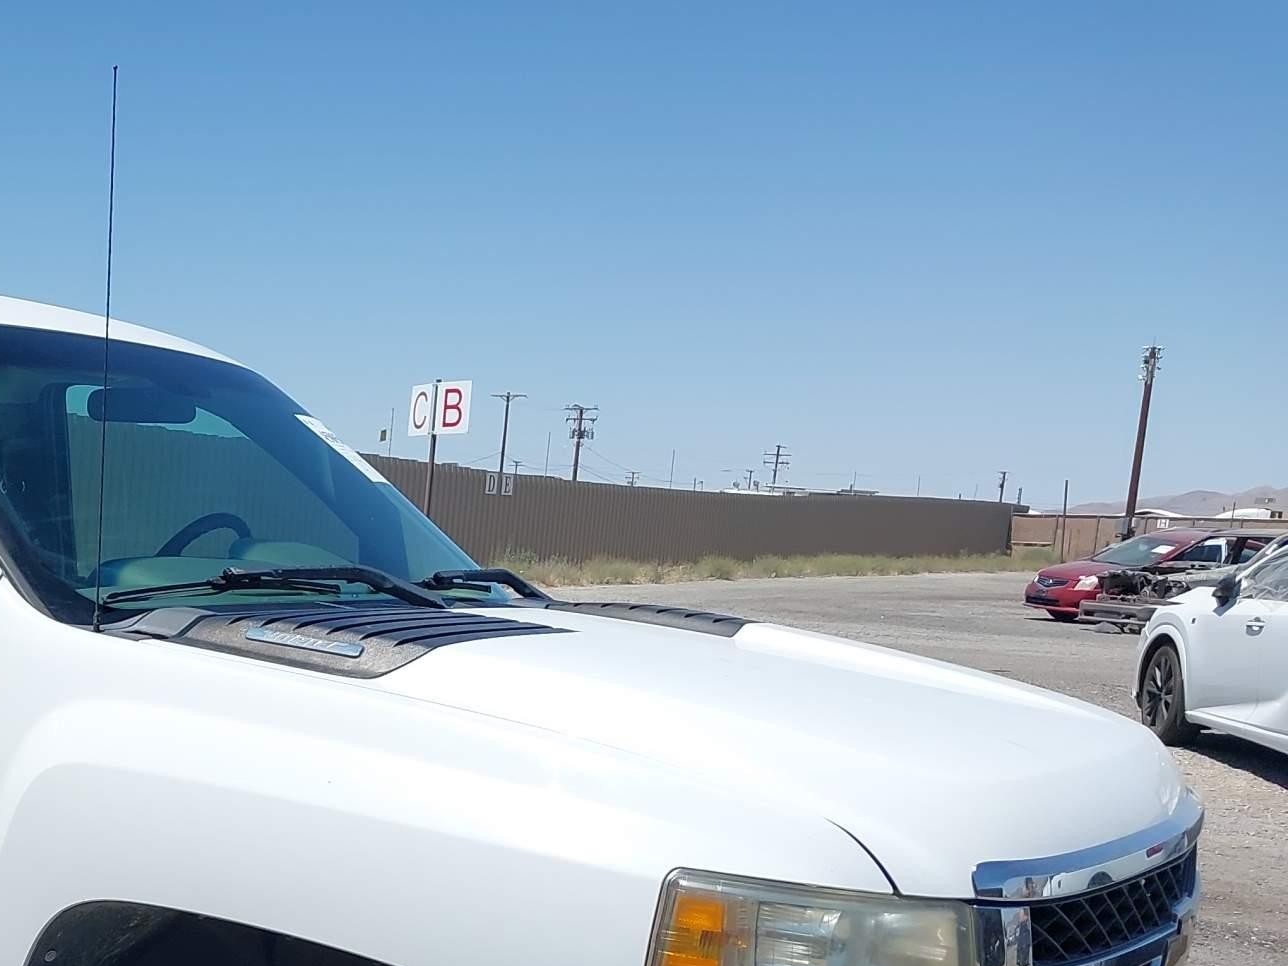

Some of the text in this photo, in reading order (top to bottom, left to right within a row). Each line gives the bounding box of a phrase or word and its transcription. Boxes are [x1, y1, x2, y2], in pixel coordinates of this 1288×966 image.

[413, 391, 428, 430] C
[442, 388, 463, 428] B
[487, 475, 496, 492] D
[504, 475, 512, 493] E
